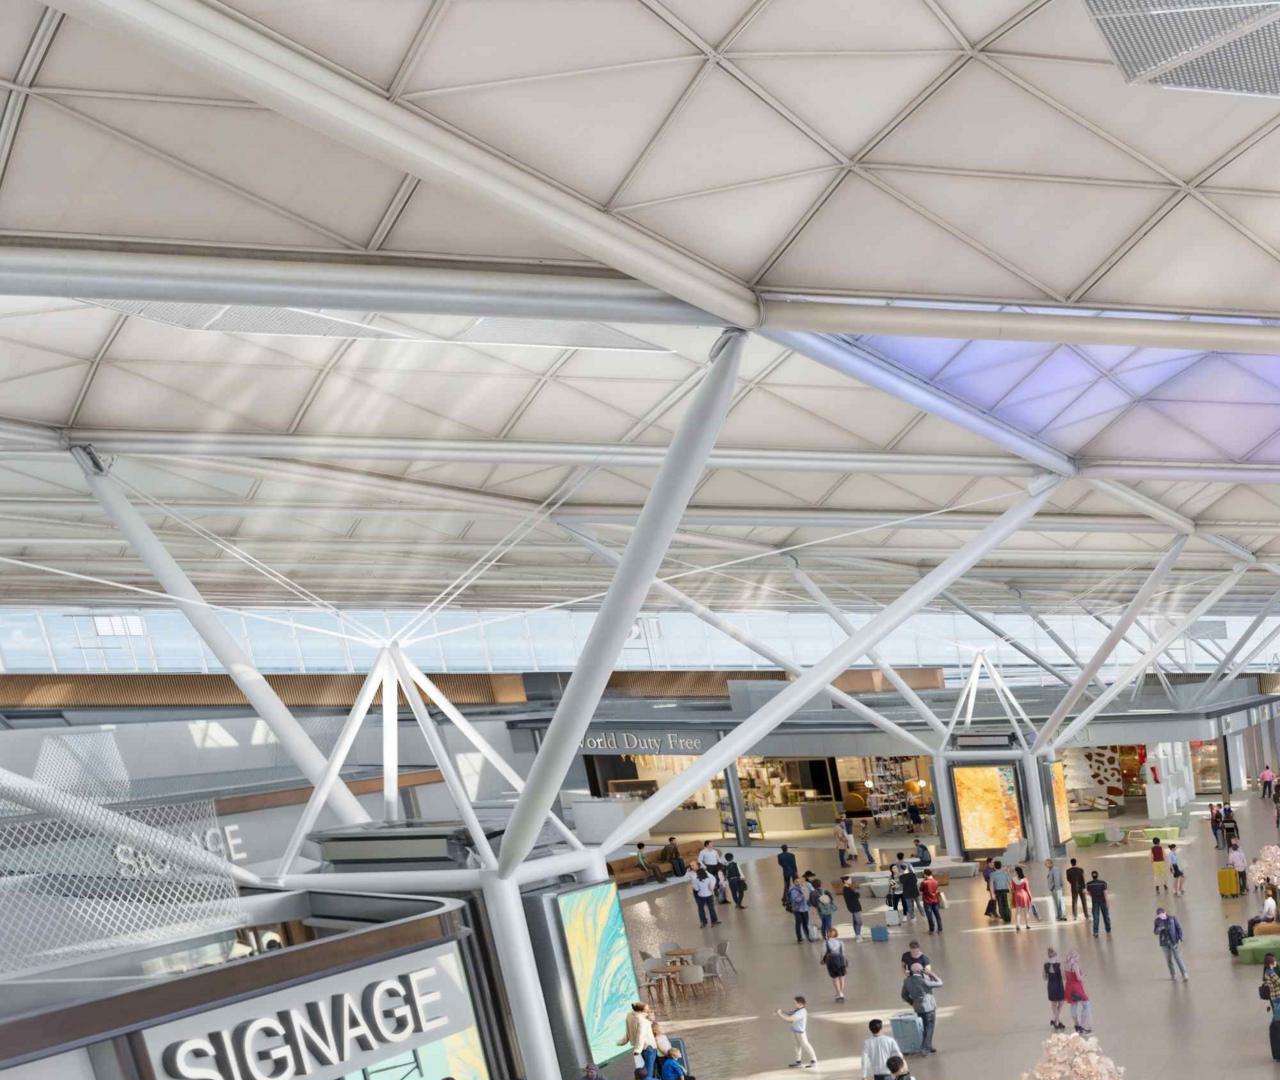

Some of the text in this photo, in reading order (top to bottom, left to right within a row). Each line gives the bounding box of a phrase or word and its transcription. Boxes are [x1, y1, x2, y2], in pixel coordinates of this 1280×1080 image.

[580, 732, 701, 754] orld Duty Free
